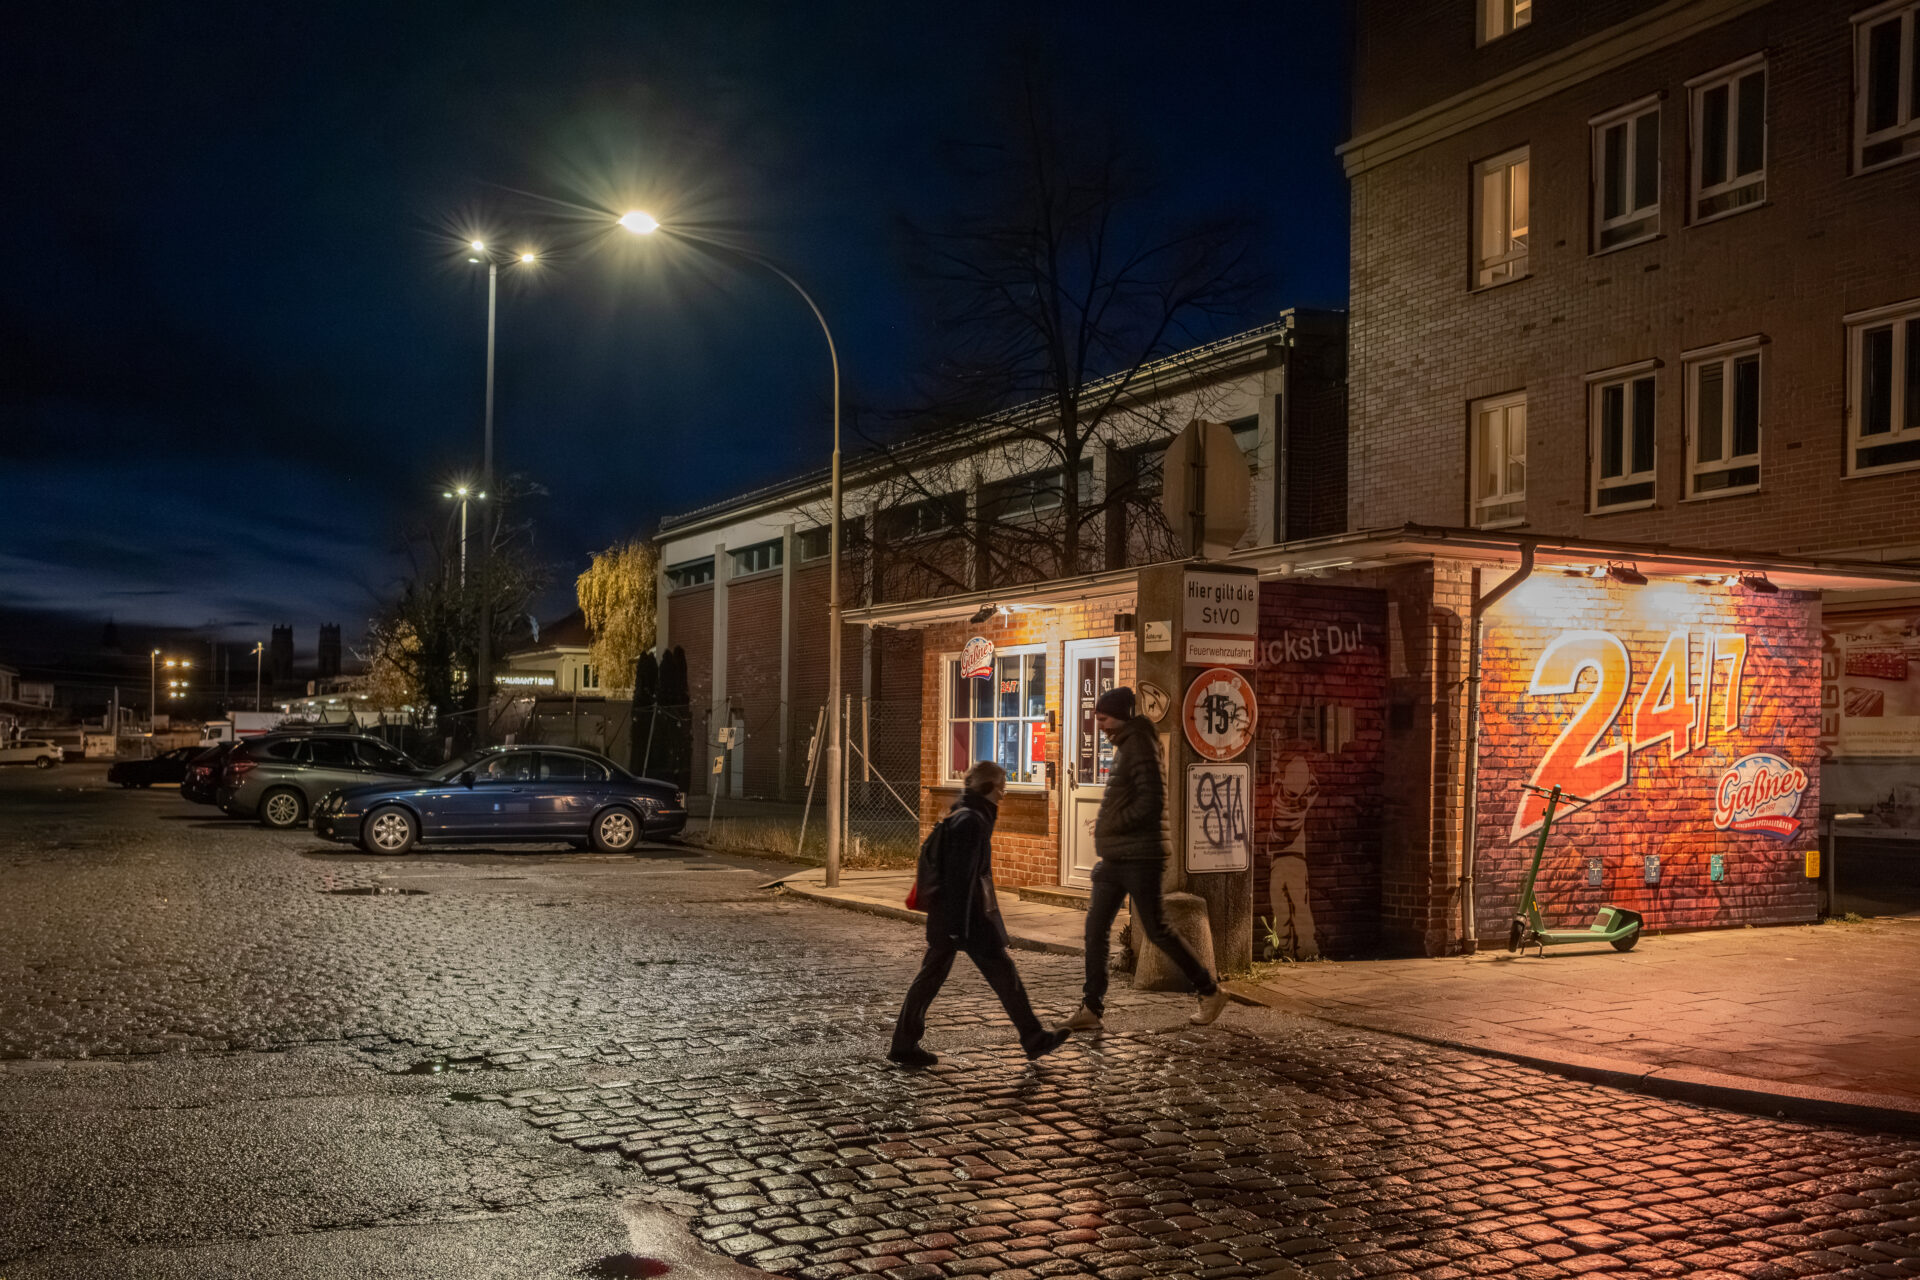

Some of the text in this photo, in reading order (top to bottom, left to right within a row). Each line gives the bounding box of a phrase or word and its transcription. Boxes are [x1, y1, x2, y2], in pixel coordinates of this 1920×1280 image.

[1188, 581, 1254, 603] Hier gilt die
[1202, 606, 1240, 625] StVO
[1189, 644, 1252, 659] Feuerwehrzufahrt
[1327, 621, 1363, 656] Du!
[1206, 694, 1230, 735] 15
[1510, 630, 1747, 843] 24/7
[1714, 767, 1806, 826] Gaßner
